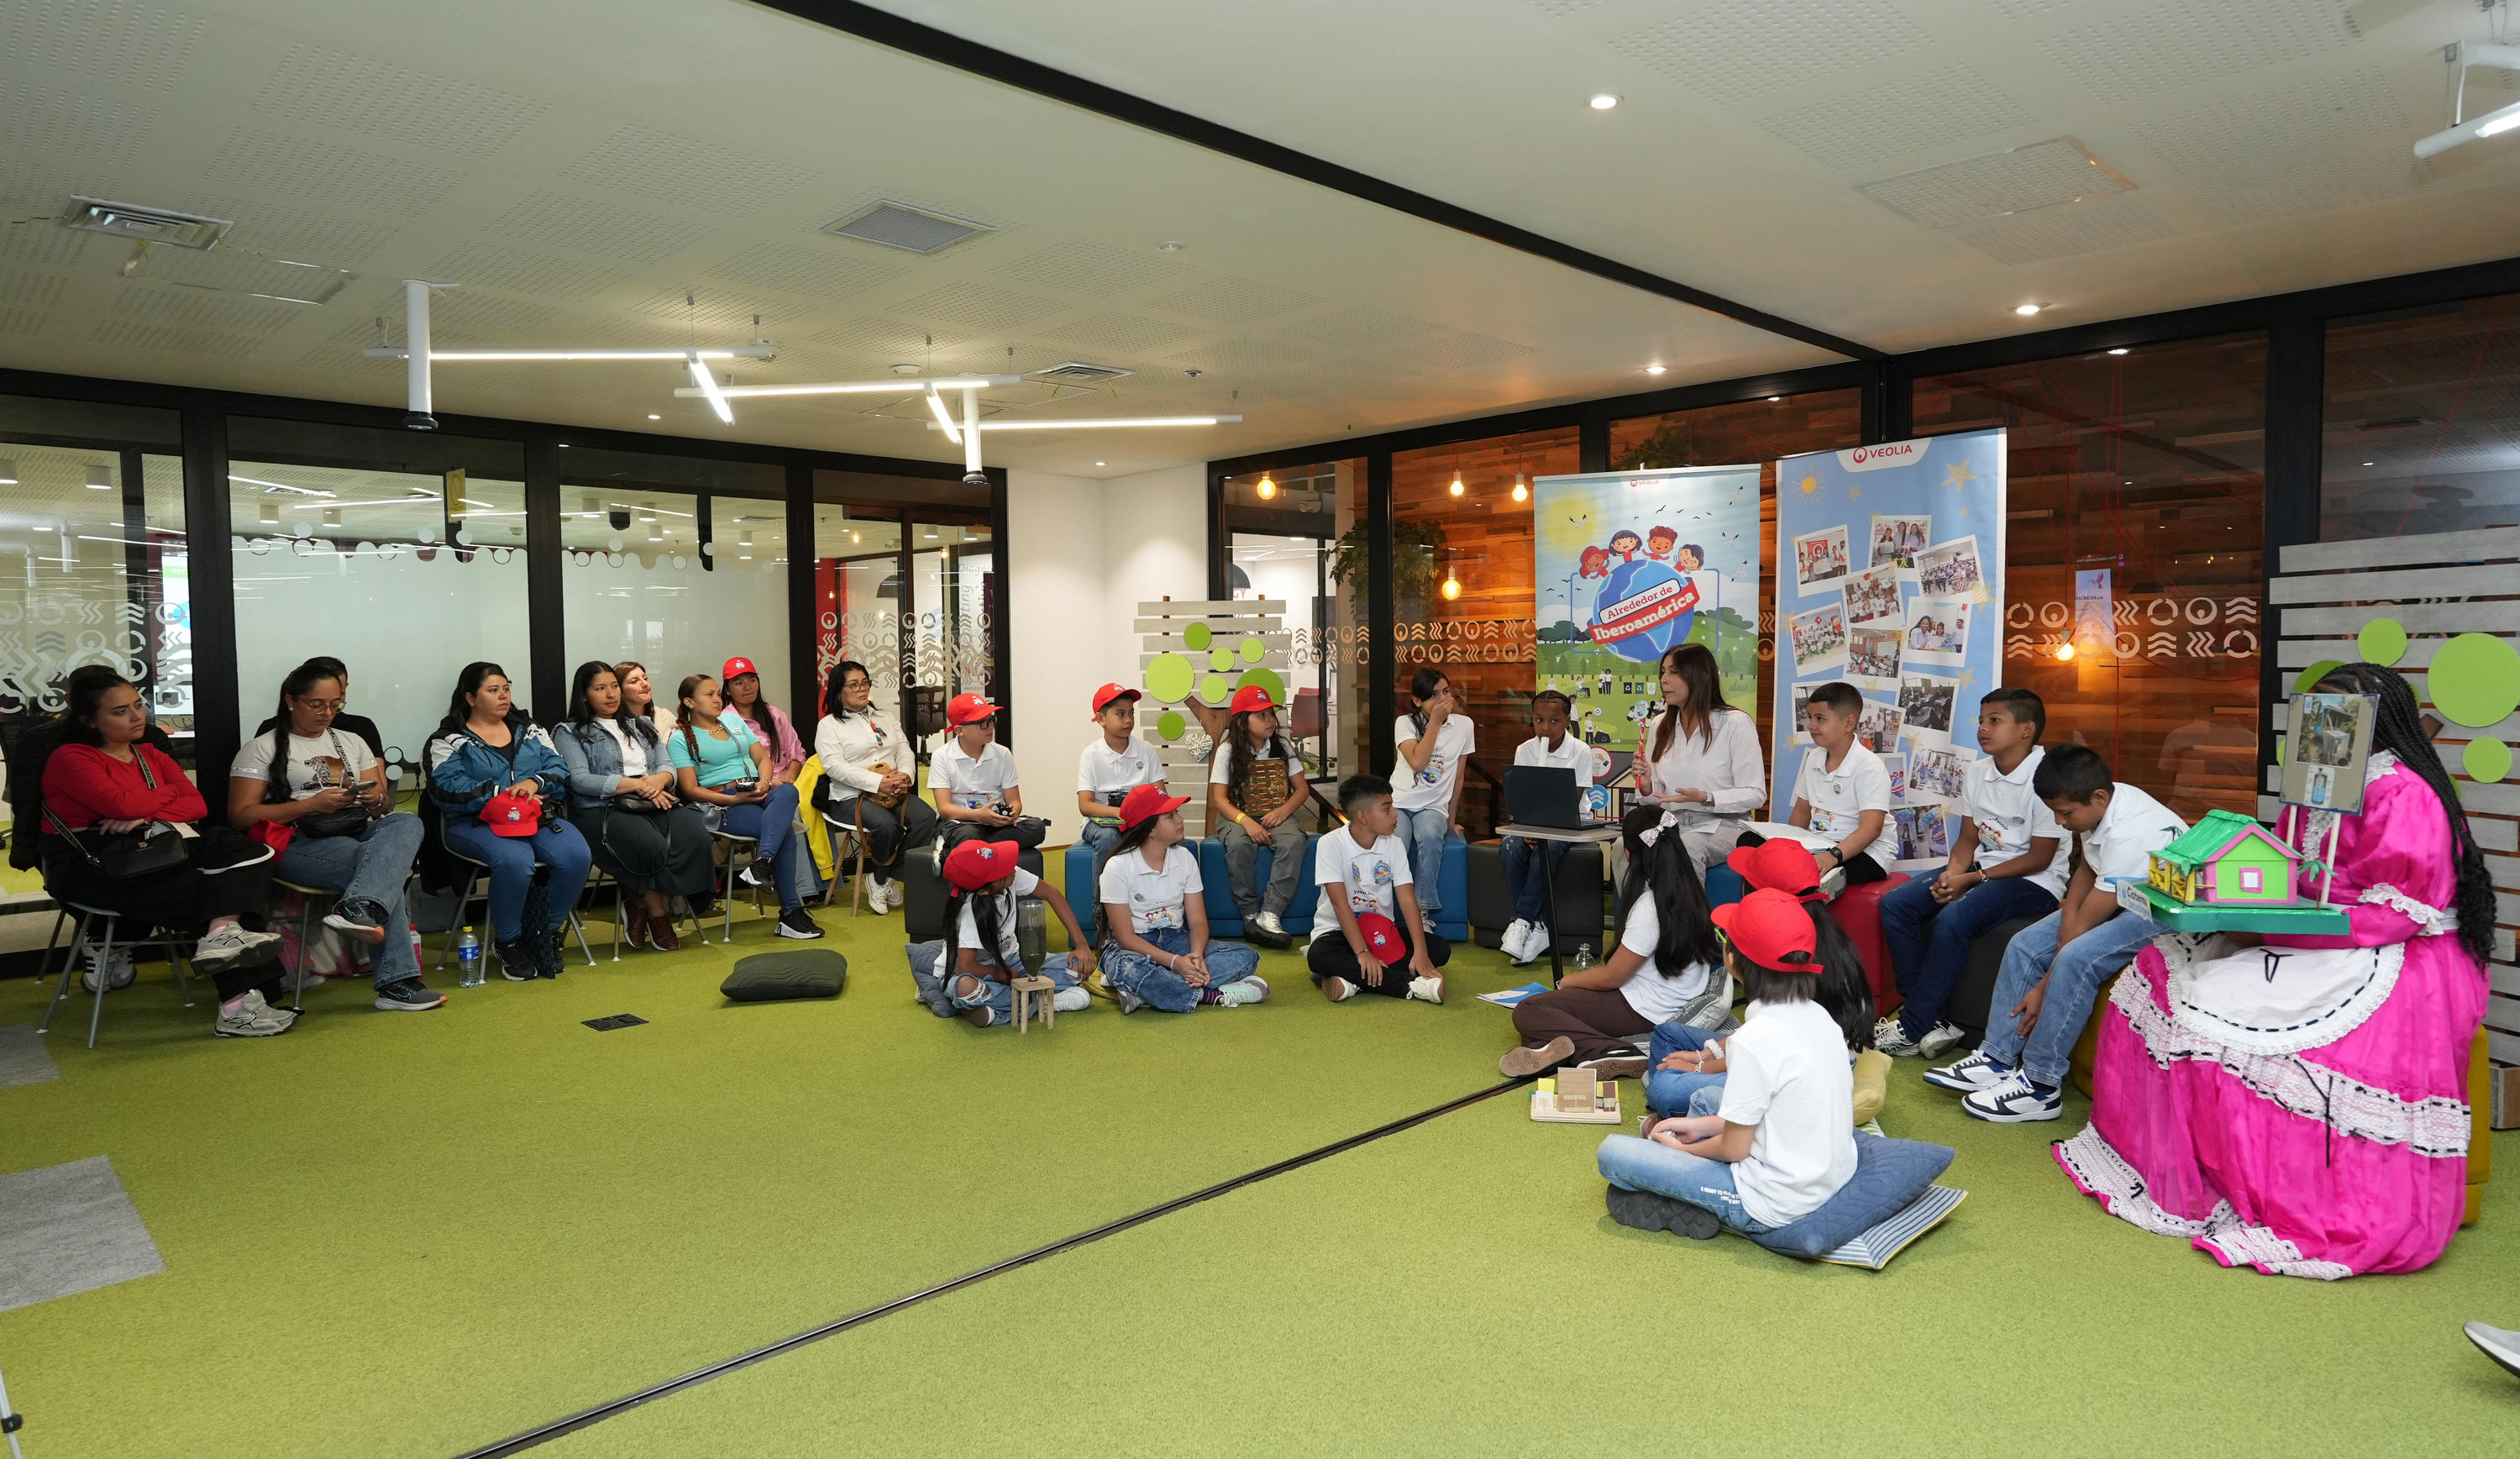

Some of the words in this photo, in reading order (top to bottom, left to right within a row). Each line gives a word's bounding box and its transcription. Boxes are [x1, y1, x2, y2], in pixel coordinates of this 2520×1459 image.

[1870, 444, 1913, 458] VEOLIA
[1593, 592, 1695, 640] Iberoamérica
[1608, 591, 1658, 619] Alrededor
[1660, 586, 1673, 596] de
